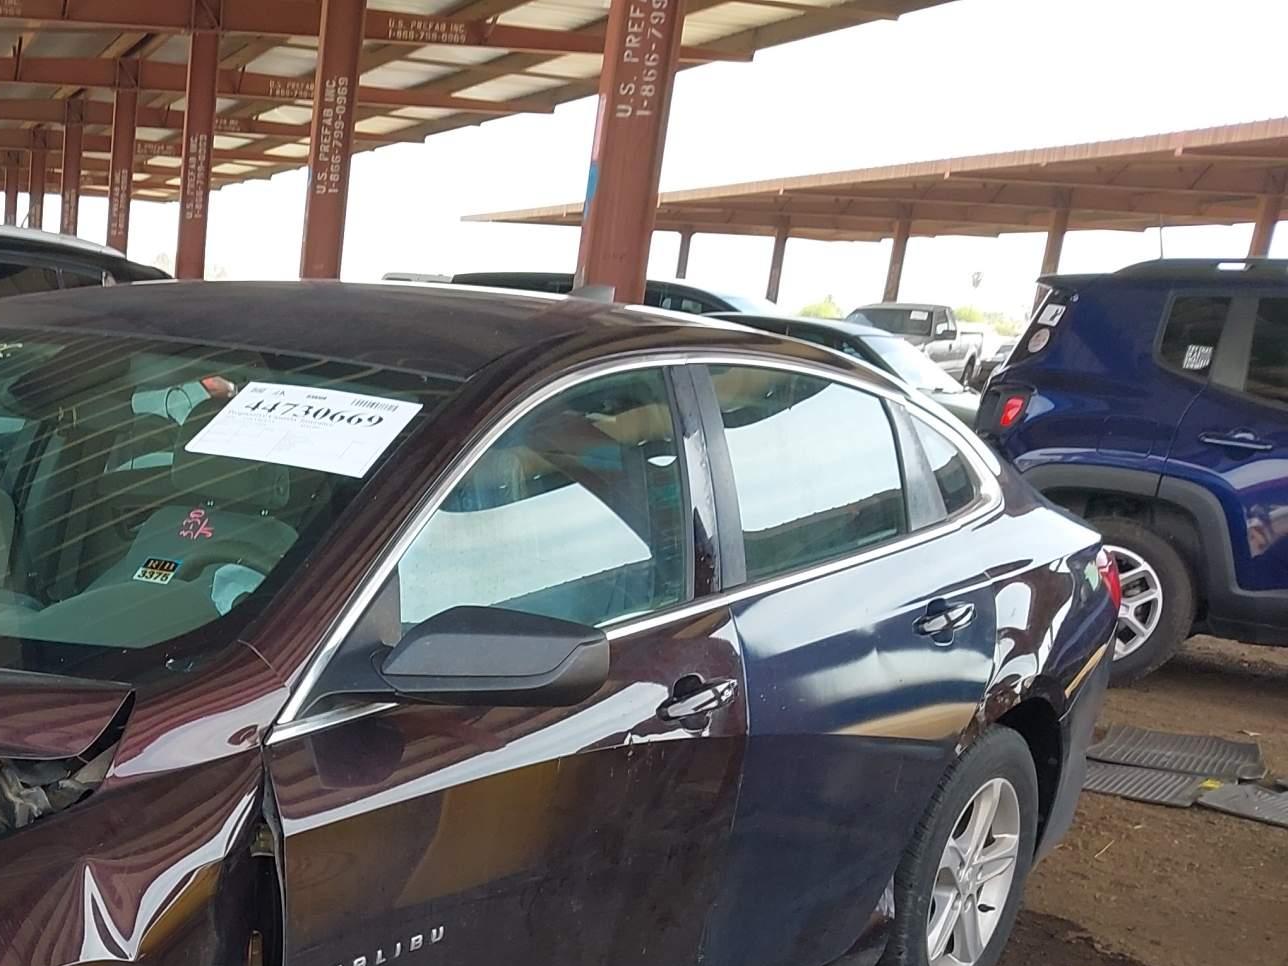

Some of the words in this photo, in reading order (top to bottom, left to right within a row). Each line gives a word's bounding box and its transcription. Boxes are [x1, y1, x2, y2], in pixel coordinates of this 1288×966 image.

[623, 0, 648, 63] PREF
[615, 75, 638, 118] U.S.
[318, 107, 334, 162] PREFAB
[328, 76, 349, 194] 1-866-799-0969
[315, 167, 330, 195] U.S.
[245, 399, 385, 428] 44730669
[136, 569, 170, 582] 3375
